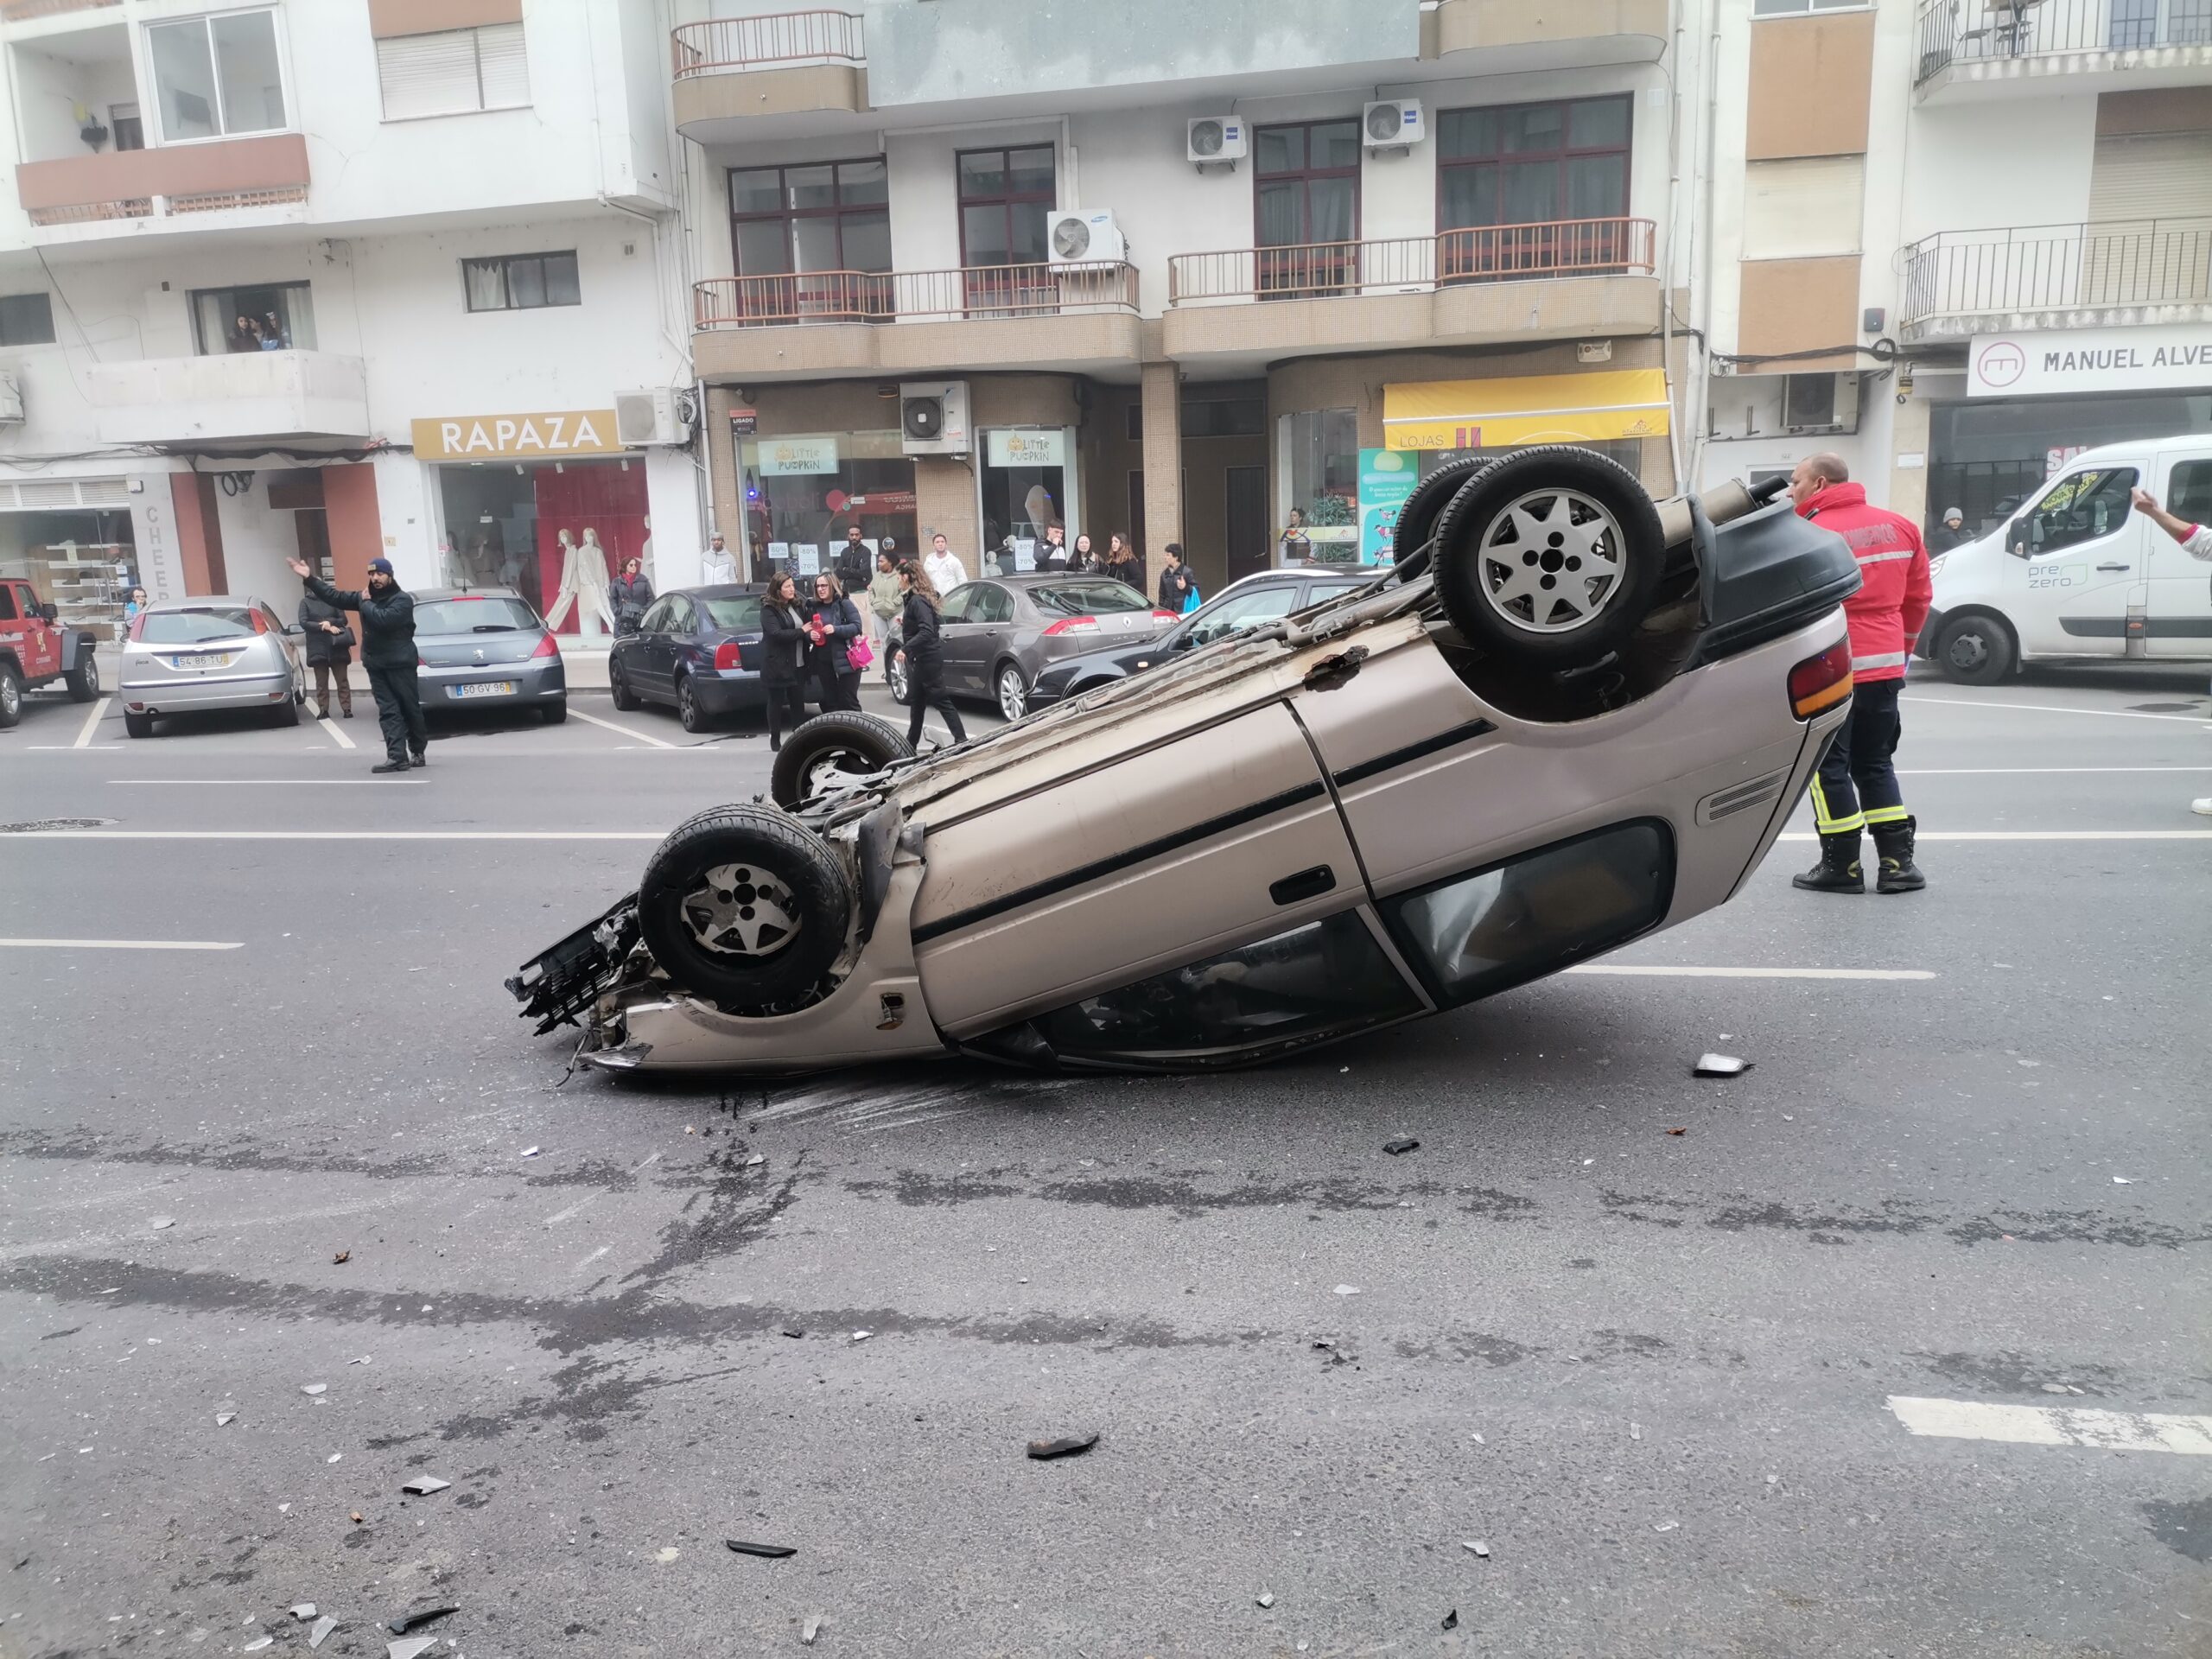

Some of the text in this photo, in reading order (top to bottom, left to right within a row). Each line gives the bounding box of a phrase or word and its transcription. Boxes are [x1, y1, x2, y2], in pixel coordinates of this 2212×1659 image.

[2044, 345, 2212, 372] MANUEL ALVE
[441, 416, 603, 454] RAPAZA
[1400, 435, 1445, 448] LOJAS
[2028, 565, 2060, 578] pre
[2028, 578, 2072, 588] zero
